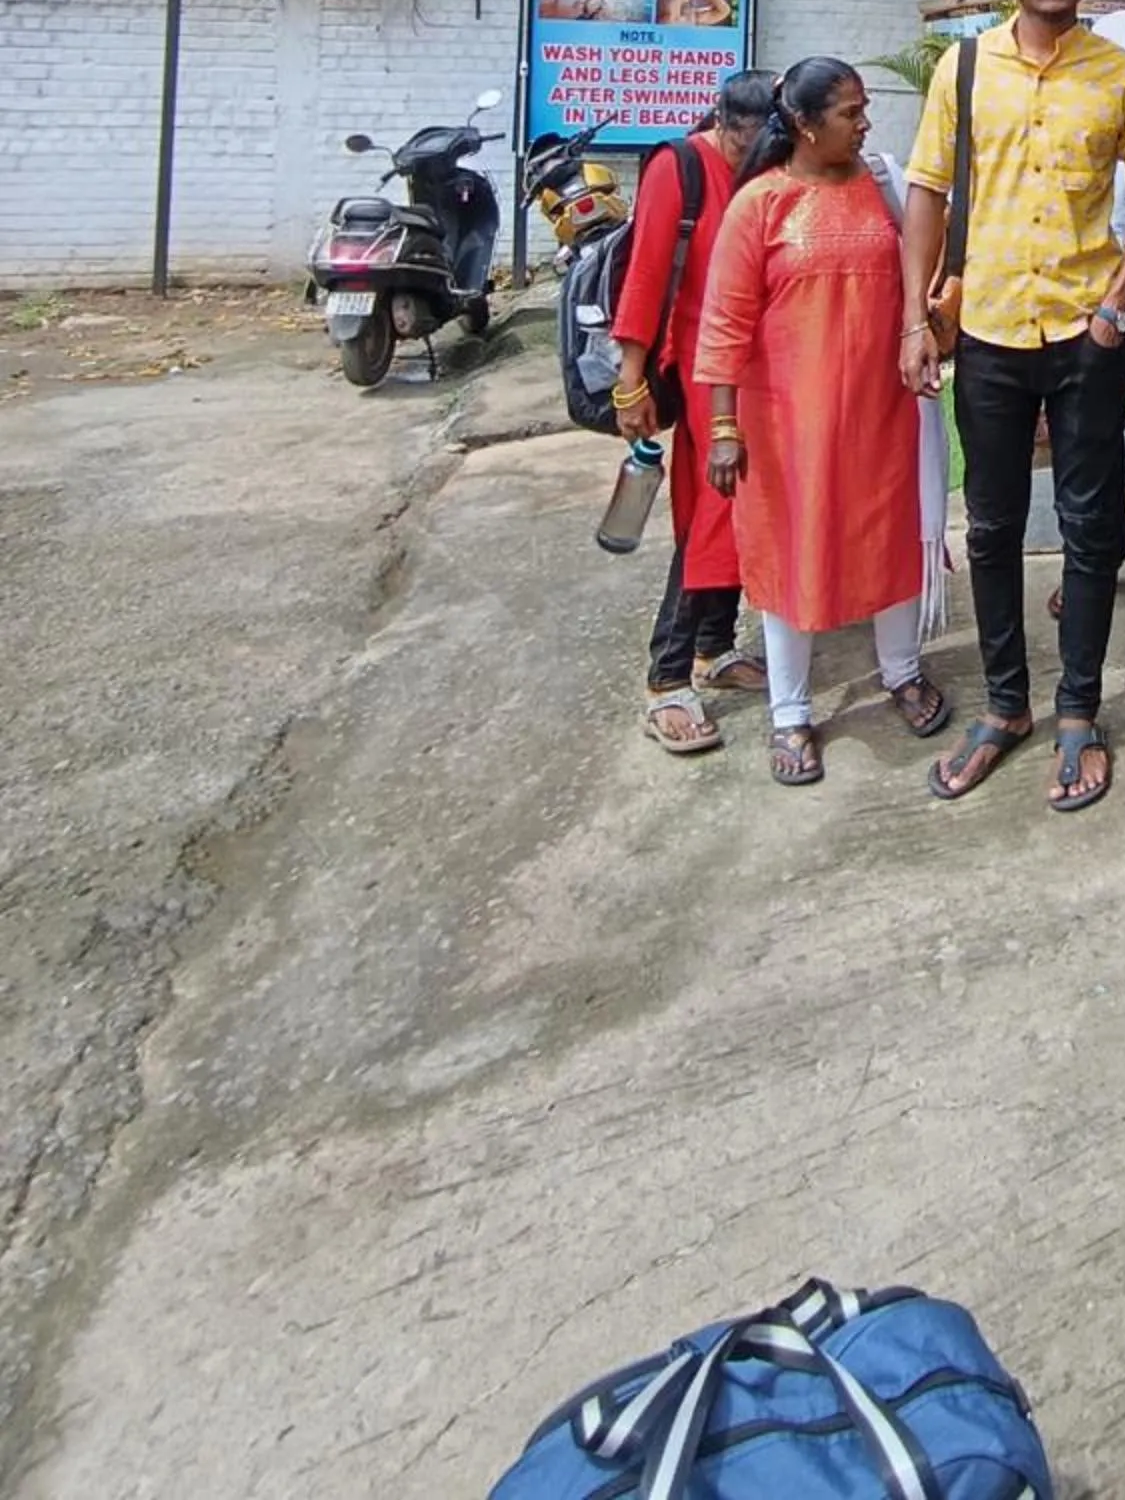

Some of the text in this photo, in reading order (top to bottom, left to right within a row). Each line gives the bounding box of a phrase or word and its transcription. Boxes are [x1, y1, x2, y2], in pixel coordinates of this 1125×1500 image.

[543, 45, 736, 66] WASH YOUR HANDS
[561, 67, 718, 86] AND LEGS HERE
[551, 87, 615, 103] AFTER
[565, 108, 705, 126] IN THE BEACH
